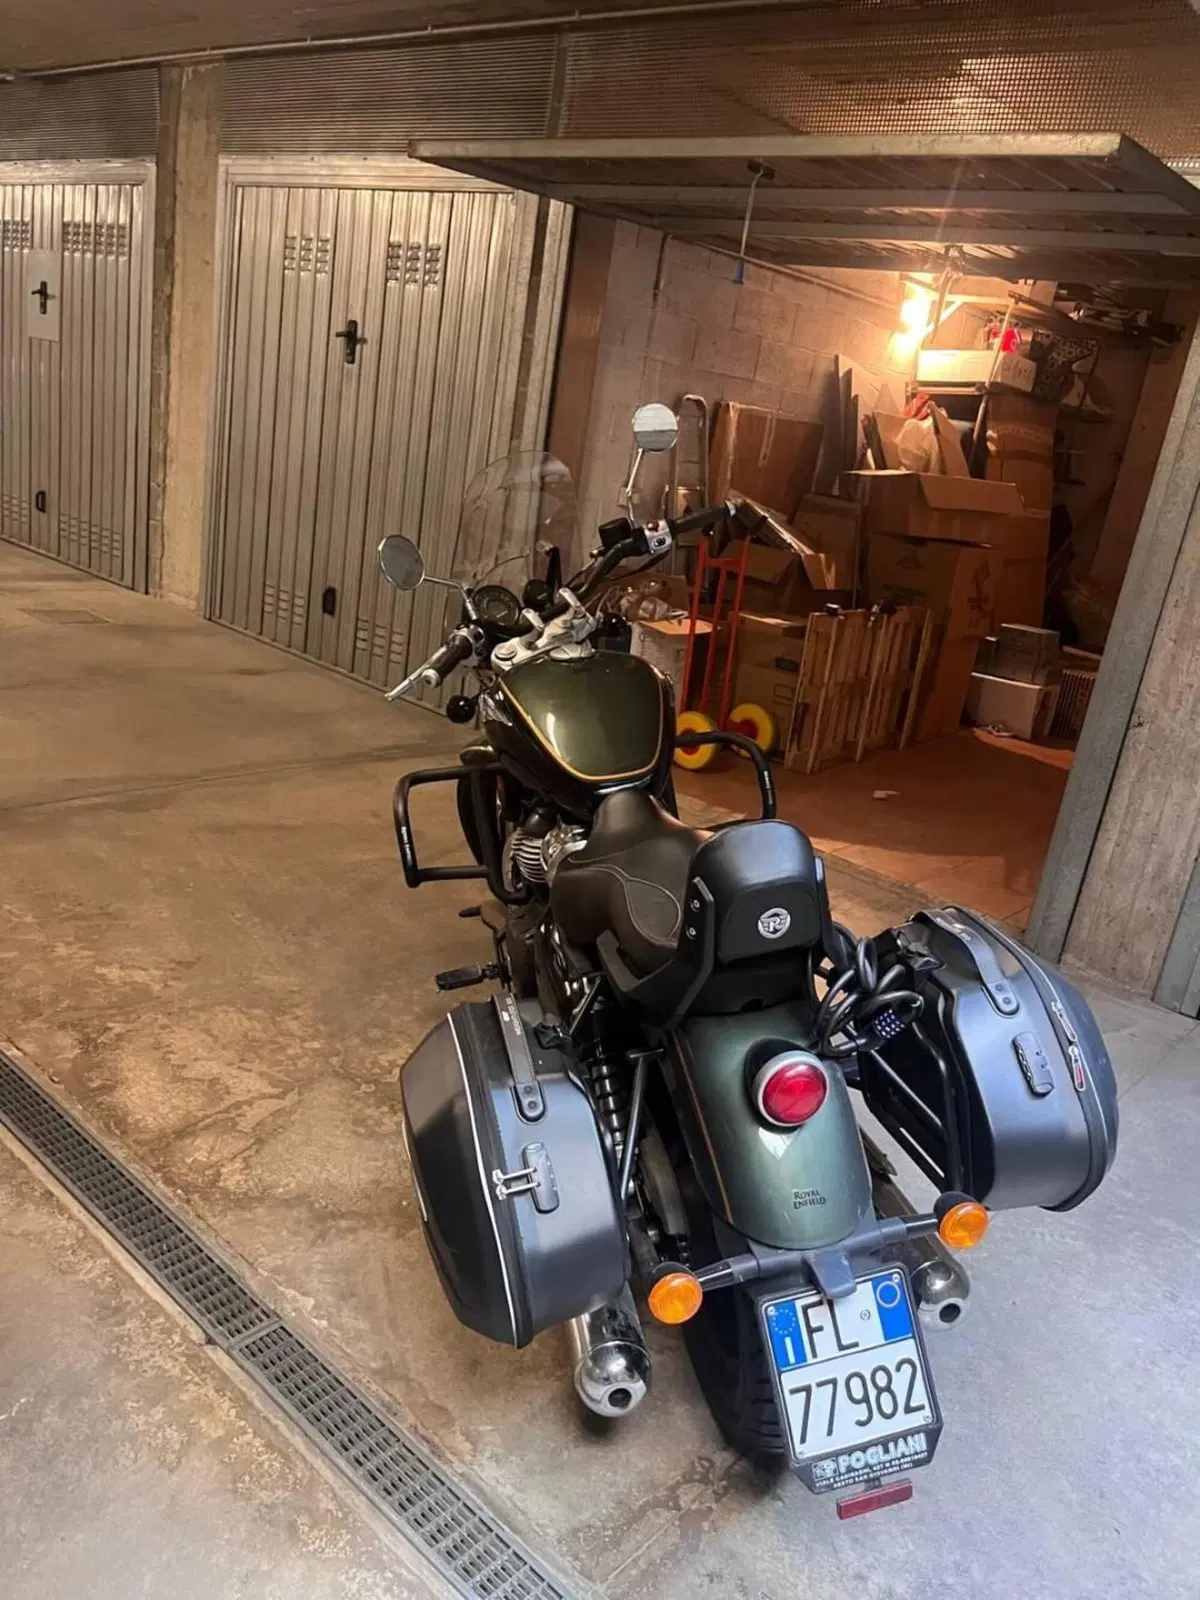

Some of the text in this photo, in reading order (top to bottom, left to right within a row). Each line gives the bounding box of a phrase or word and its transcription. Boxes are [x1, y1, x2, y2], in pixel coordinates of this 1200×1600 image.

[793, 1189, 821, 1200] ROYAL
[793, 1196, 827, 1210] ENFIELD
[801, 1298, 860, 1359] FL
[788, 1357, 926, 1445] 77982
[837, 1432, 927, 1473] POGLIANI
